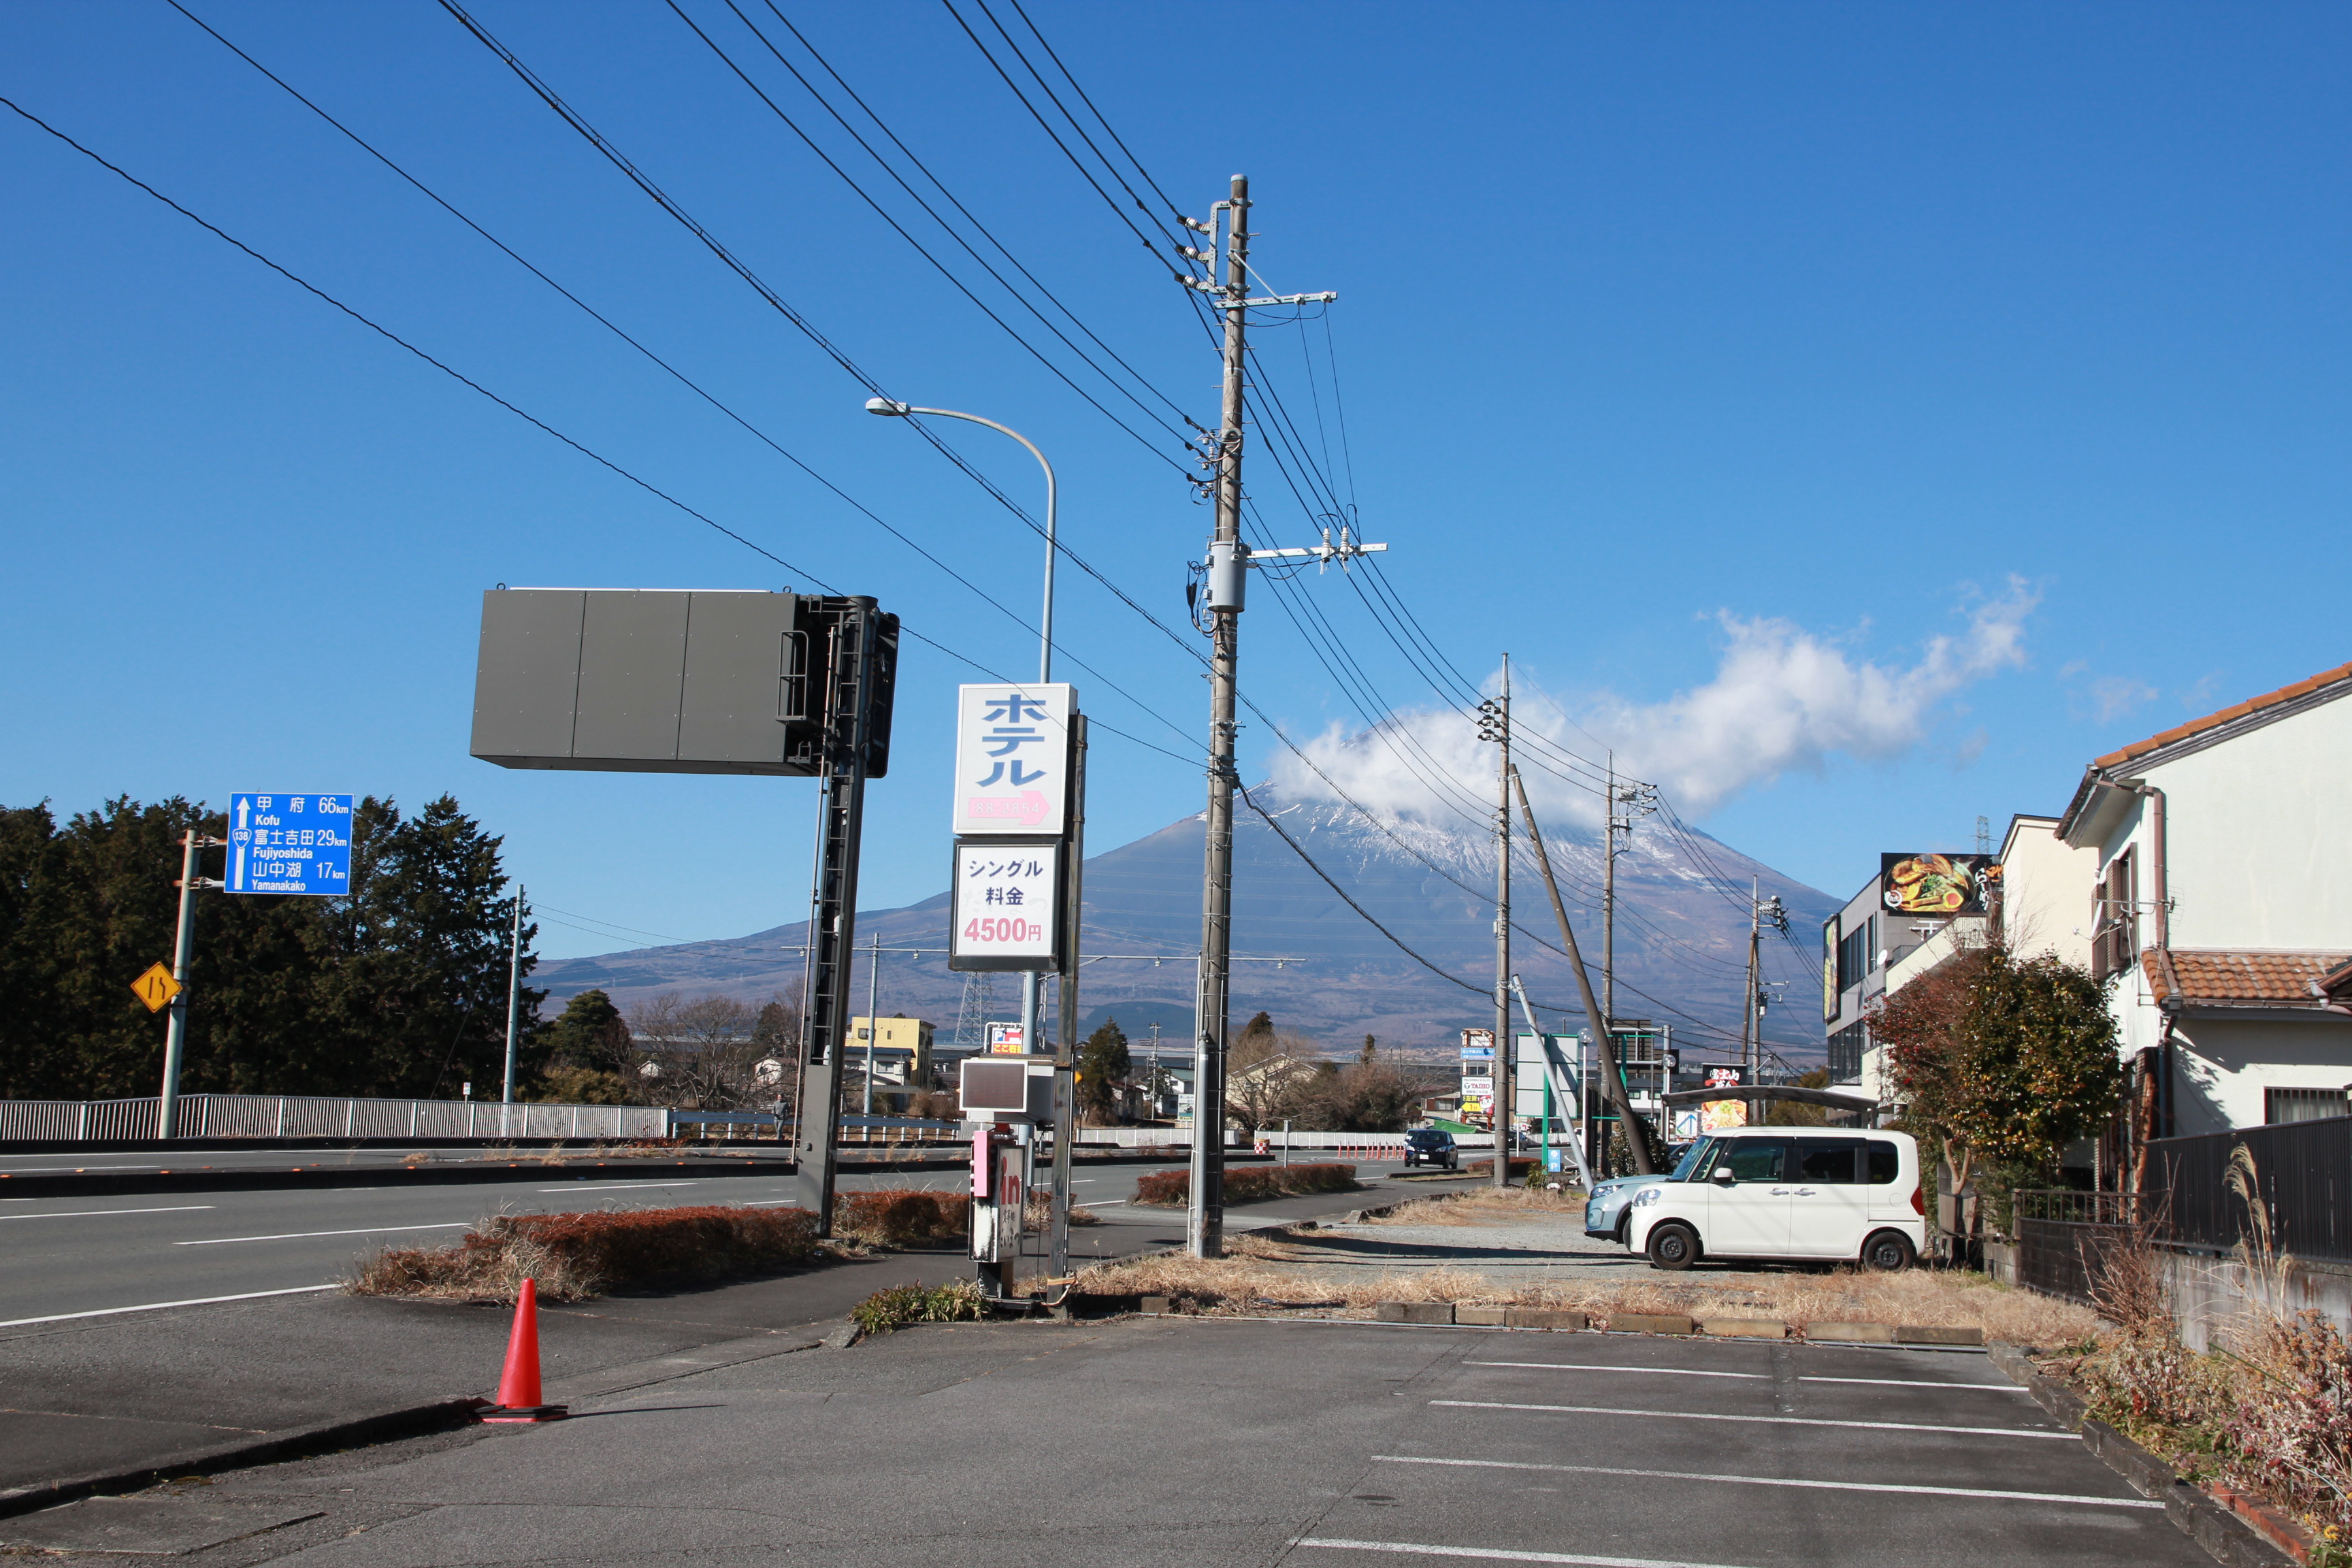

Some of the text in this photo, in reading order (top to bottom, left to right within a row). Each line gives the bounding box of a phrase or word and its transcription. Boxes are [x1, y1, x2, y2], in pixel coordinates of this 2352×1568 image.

[975, 693, 1049, 787] ホテル
[257, 796, 348, 814] 甲府 66km
[975, 802, 1040, 814] 88-2854
[255, 815, 280, 826] Kofu
[234, 831, 248, 841] 138
[255, 829, 347, 847] 富士吉田 29km
[253, 847, 313, 860] Fujiyoshida
[252, 861, 345, 879] 山中湖 17km
[969, 859, 1044, 878] シングル
[252, 879, 306, 892] Yamanakako
[985, 886, 1024, 905] 料金
[964, 917, 1041, 942] 4500円
[1710, 1068, 1740, 1081] 富士山
